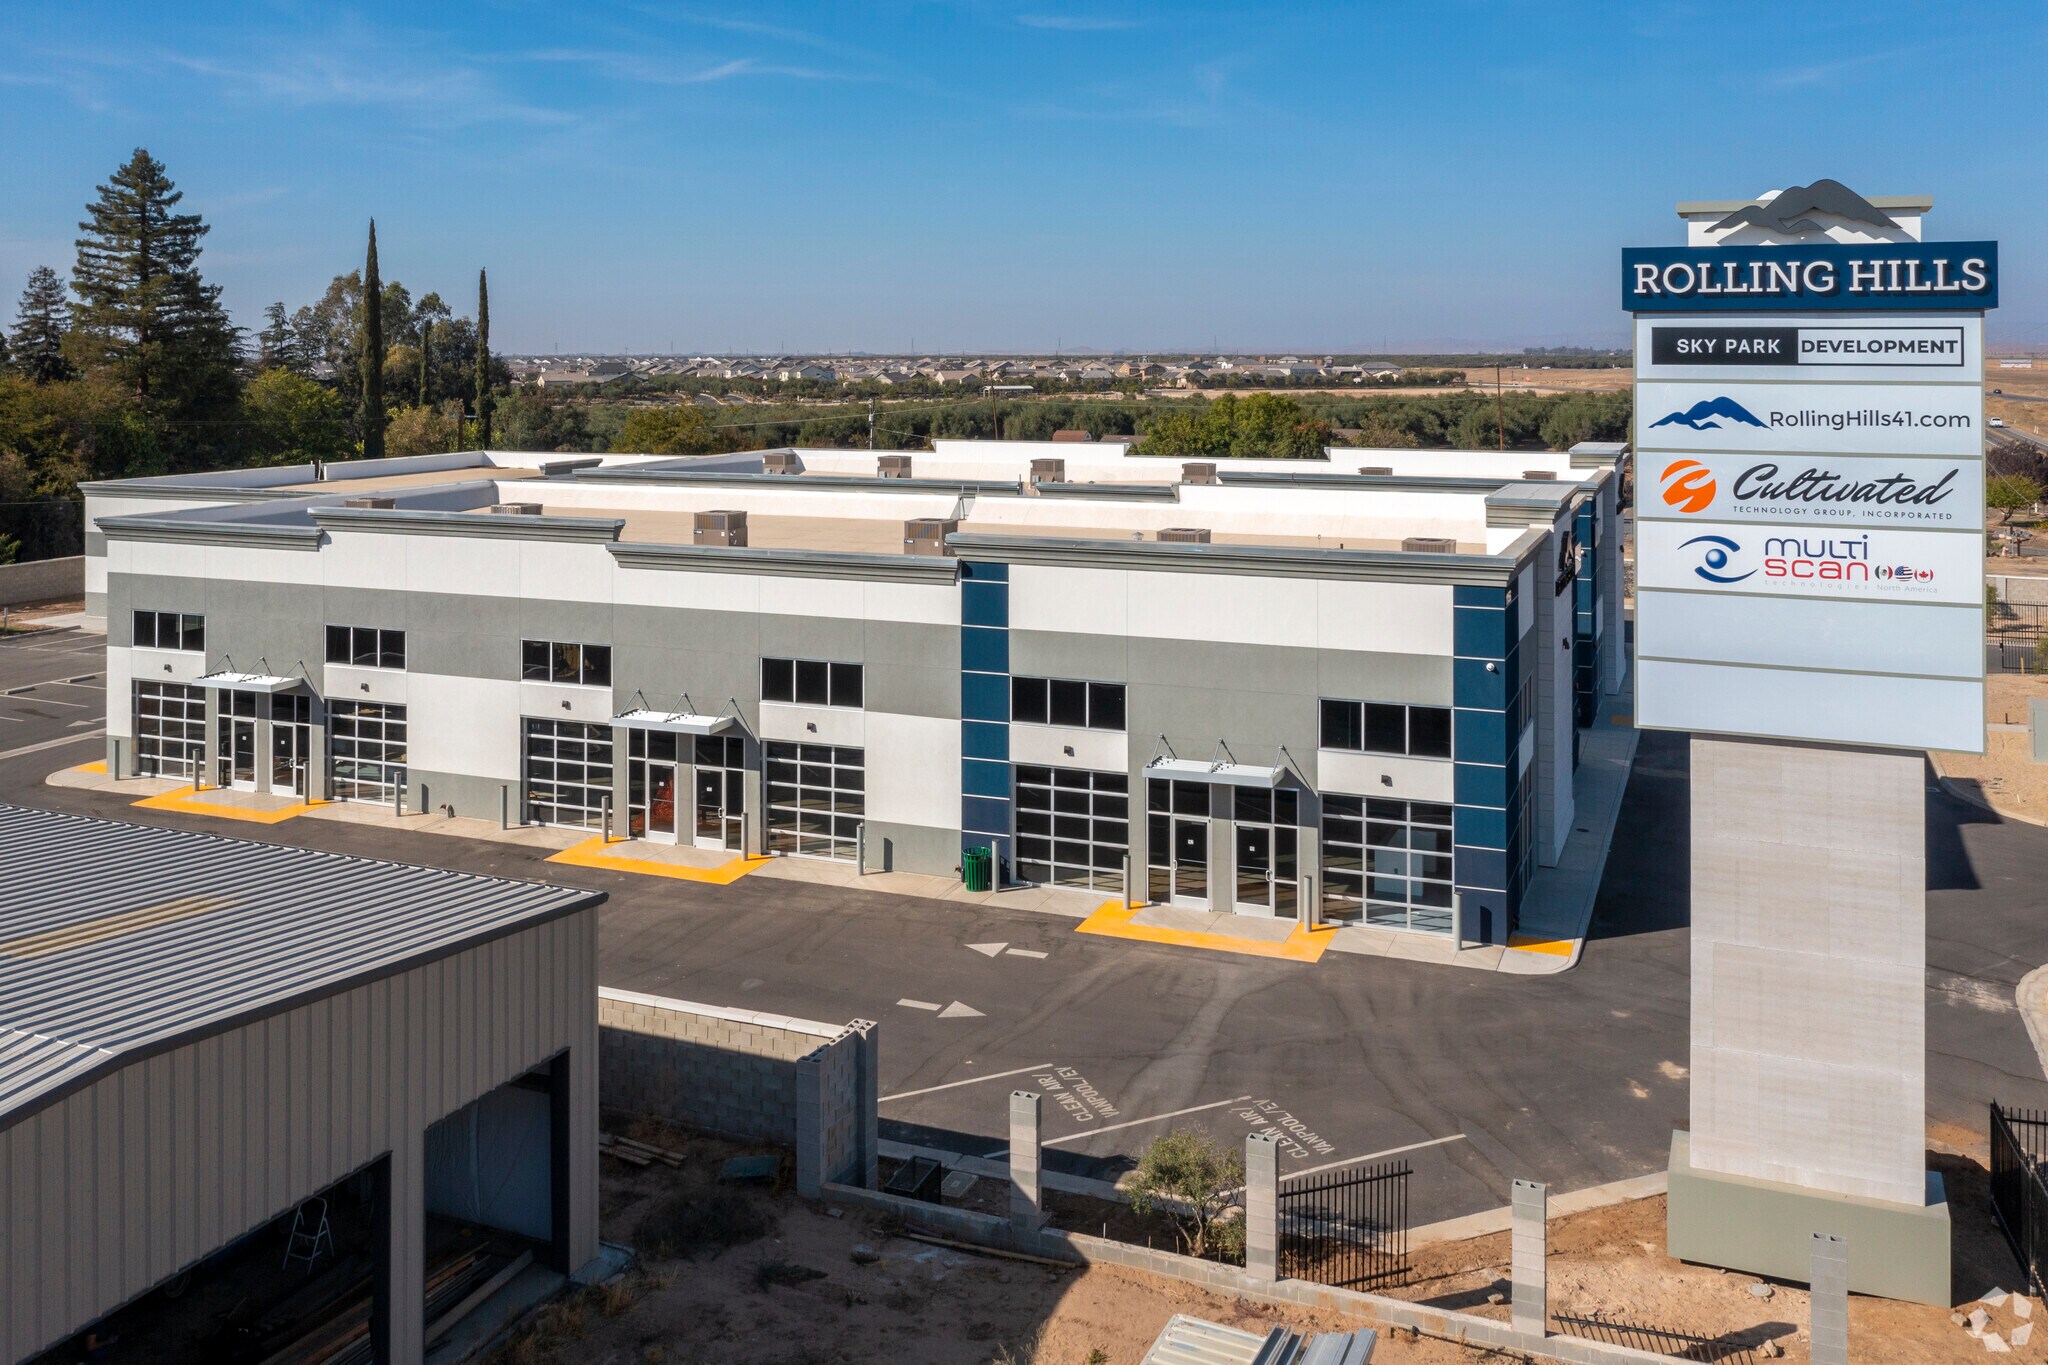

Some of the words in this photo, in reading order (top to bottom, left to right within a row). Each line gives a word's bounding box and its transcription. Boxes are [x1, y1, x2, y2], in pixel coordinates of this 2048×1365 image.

[1633, 260, 1835, 295] ROLLING
[1848, 258, 1986, 293] HILLS
[1676, 338, 1717, 354] SKY
[1725, 338, 1781, 354] PARK
[1801, 339, 1959, 354] DEVELOPMENT
[1769, 409, 1971, 431] RollingHills41.com
[1733, 463, 1960, 505] Cultivated
[1733, 505, 1807, 516] TECHNOLOGY
[1814, 508, 1856, 519] GROUP,
[1862, 510, 1953, 521] INCORPORATED
[1765, 558, 1868, 581] scan
[1764, 579, 1869, 591] technologies
[1876, 584, 1901, 592] North
[1904, 585, 1939, 594] America
[1053, 1092, 1094, 1122] CLEAN
